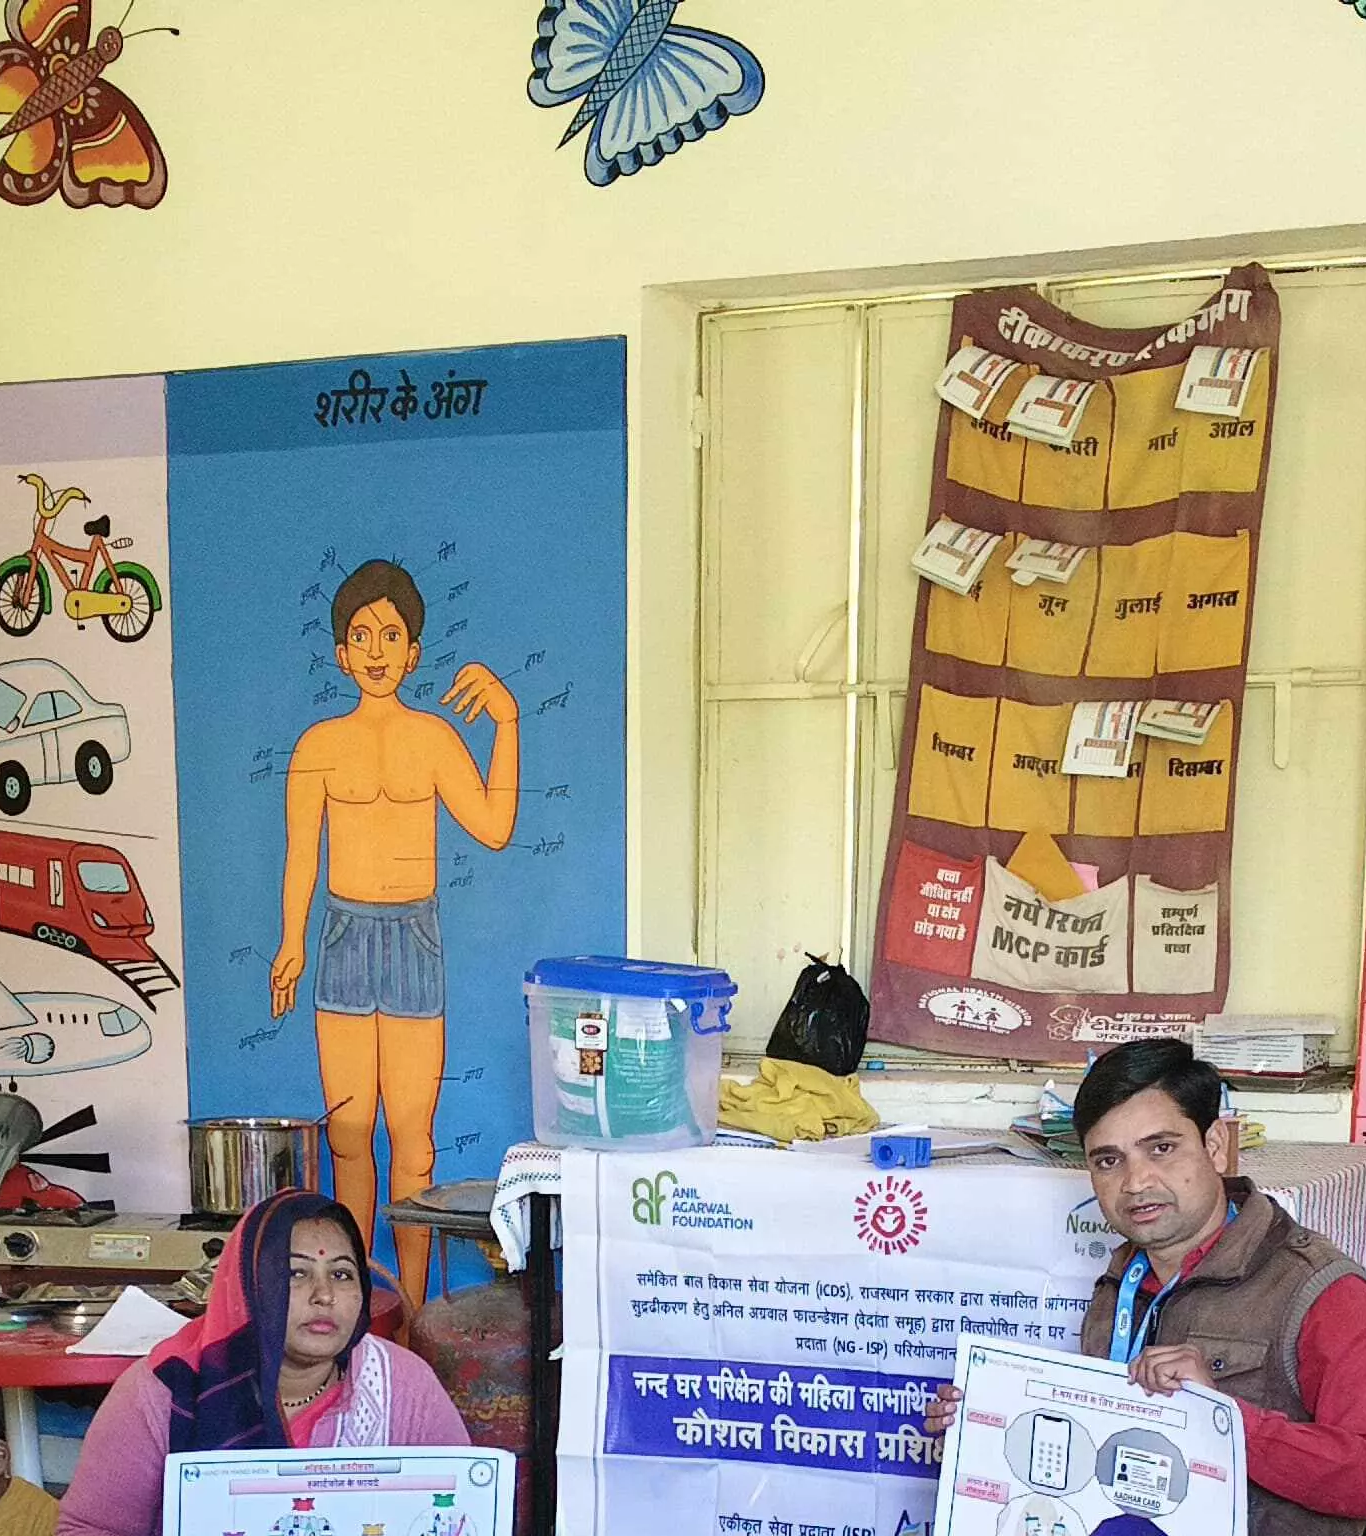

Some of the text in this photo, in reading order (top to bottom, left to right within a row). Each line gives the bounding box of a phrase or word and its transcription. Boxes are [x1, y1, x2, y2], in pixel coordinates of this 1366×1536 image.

[313, 368, 487, 427] शरीर के अंग
[970, 418, 1012, 444] नवरी
[1049, 437, 1099, 459] वरी
[1168, 757, 1225, 777] दिसम्बर
[991, 925, 1110, 968] MCP कार्ड
[1090, 1019, 1186, 1034] टीकाकरण
[672, 1187, 700, 1199] ANIL
[672, 1202, 731, 1215] AGARWAL
[672, 1216, 753, 1230] FOUNDATION
[636, 1270, 677, 1287] समेकित
[685, 1275, 703, 1289] बाल
[708, 1274, 741, 1291] विकास
[748, 1276, 768, 1292] सेवा
[775, 1276, 809, 1296] योजना
[860, 1286, 908, 1300] राजस्थान
[915, 1290, 953, 1304] सरकार
[990, 1290, 1037, 1309] संचालित
[693, 1297, 710, 1320] हेतु
[713, 1301, 743, 1318] अनिल
[749, 1307, 787, 1322] अग्रवाल
[1049, 1326, 1065, 1341] घर
[795, 1337, 827, 1352] प्रदाता
[633, 1372, 669, 1399] नन्द
[673, 1373, 702, 1399] घर
[707, 1368, 764, 1404] परिक्षेत्र
[769, 1371, 794, 1407] की
[798, 1373, 855, 1412] महिला
[672, 1407, 763, 1450] कौशल
[771, 1413, 866, 1458] विकास
[768, 1516, 793, 1536] सेवा
